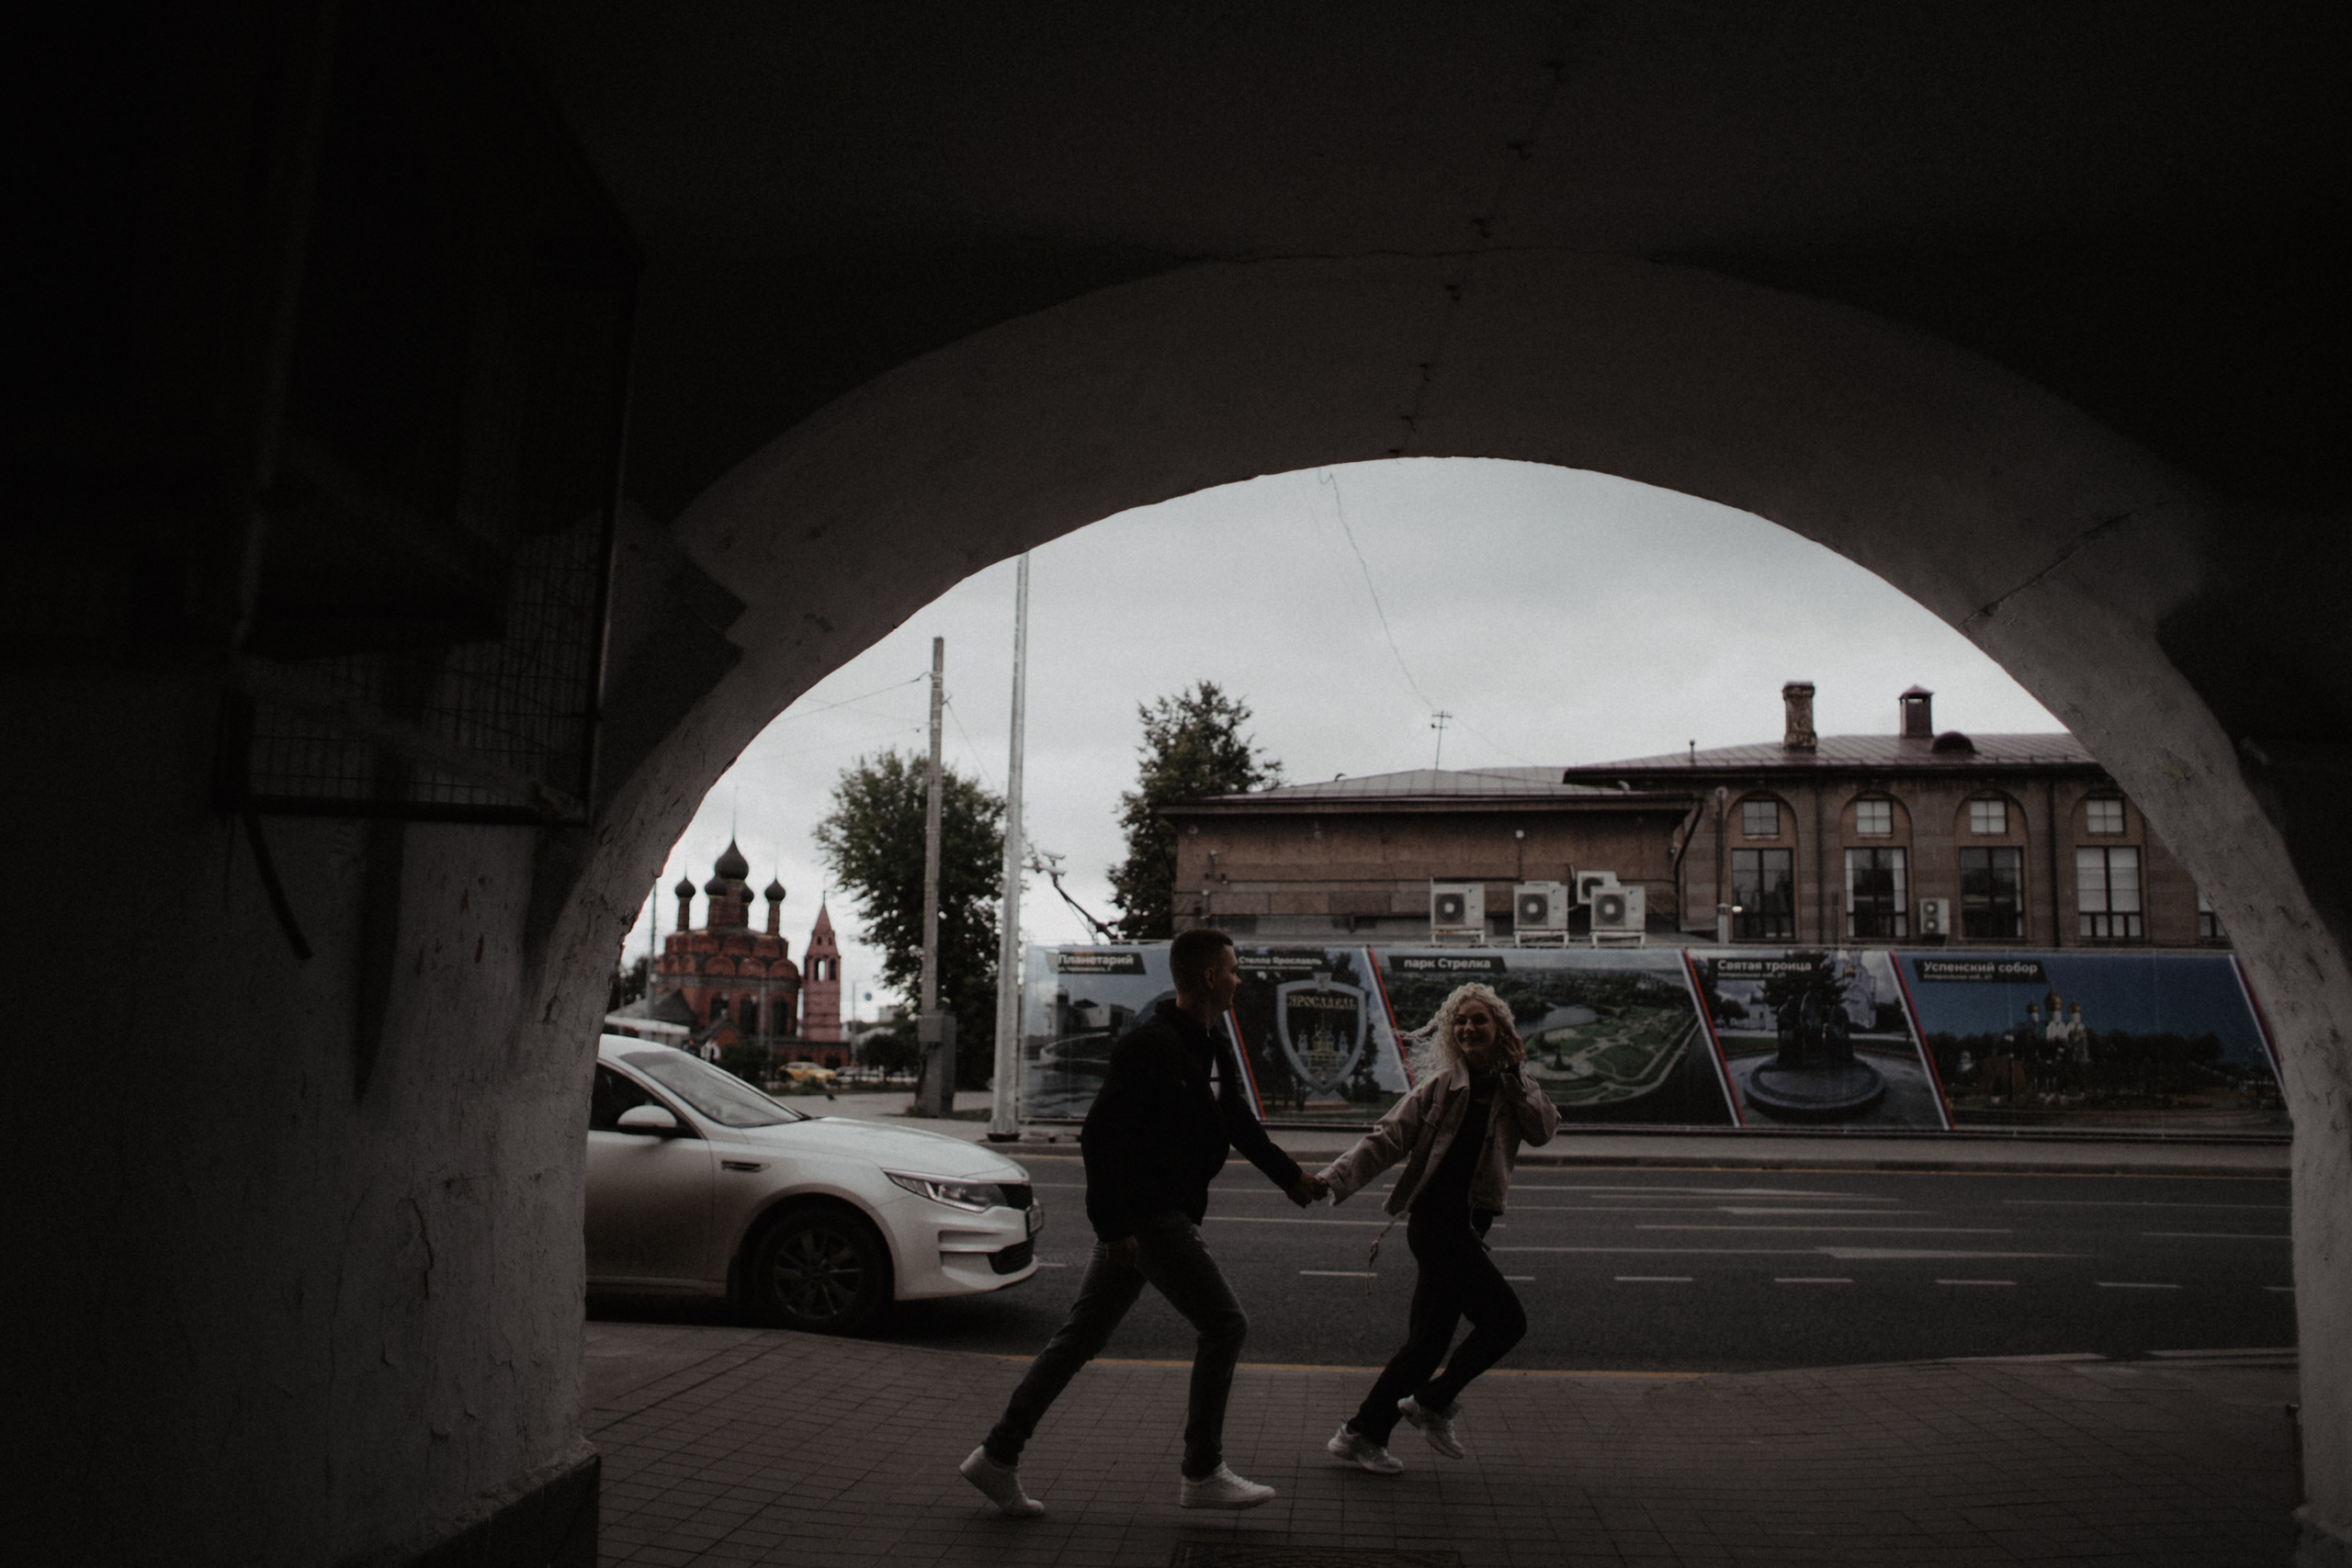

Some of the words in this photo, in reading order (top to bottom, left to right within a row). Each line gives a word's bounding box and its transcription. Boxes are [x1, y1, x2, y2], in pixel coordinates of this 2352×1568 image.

[1058, 953, 1134, 967] Планетарий
[1404, 959, 1436, 970] парк
[1437, 957, 1492, 970] Стрелка
[1717, 959, 1762, 970] Святая
[1765, 961, 1813, 972] троица
[1923, 961, 1996, 973] Успенский
[1997, 962, 2038, 976] собор
